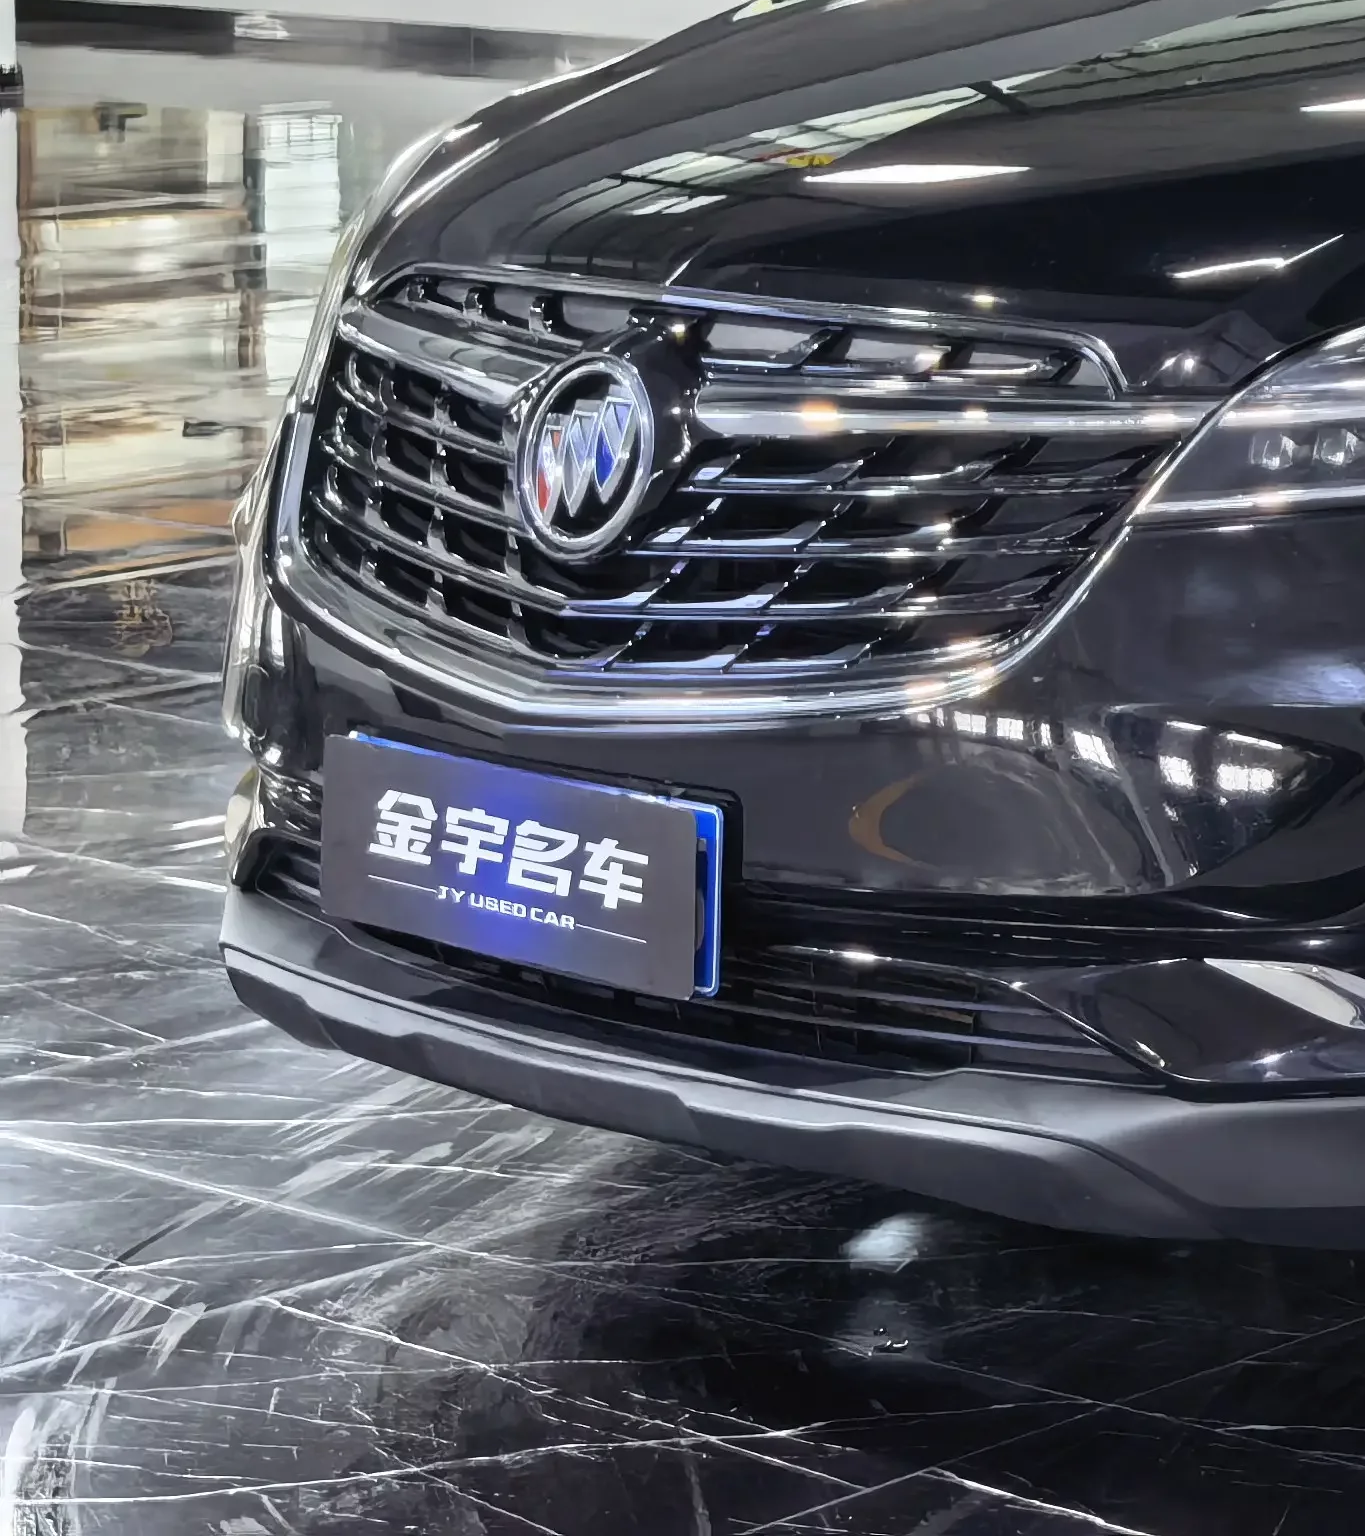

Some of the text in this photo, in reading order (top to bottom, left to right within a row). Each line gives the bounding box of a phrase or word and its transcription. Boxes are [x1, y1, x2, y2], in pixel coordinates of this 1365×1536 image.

[368, 789, 649, 909] 金宇名车
[436, 885, 576, 930] JY USED CAR
